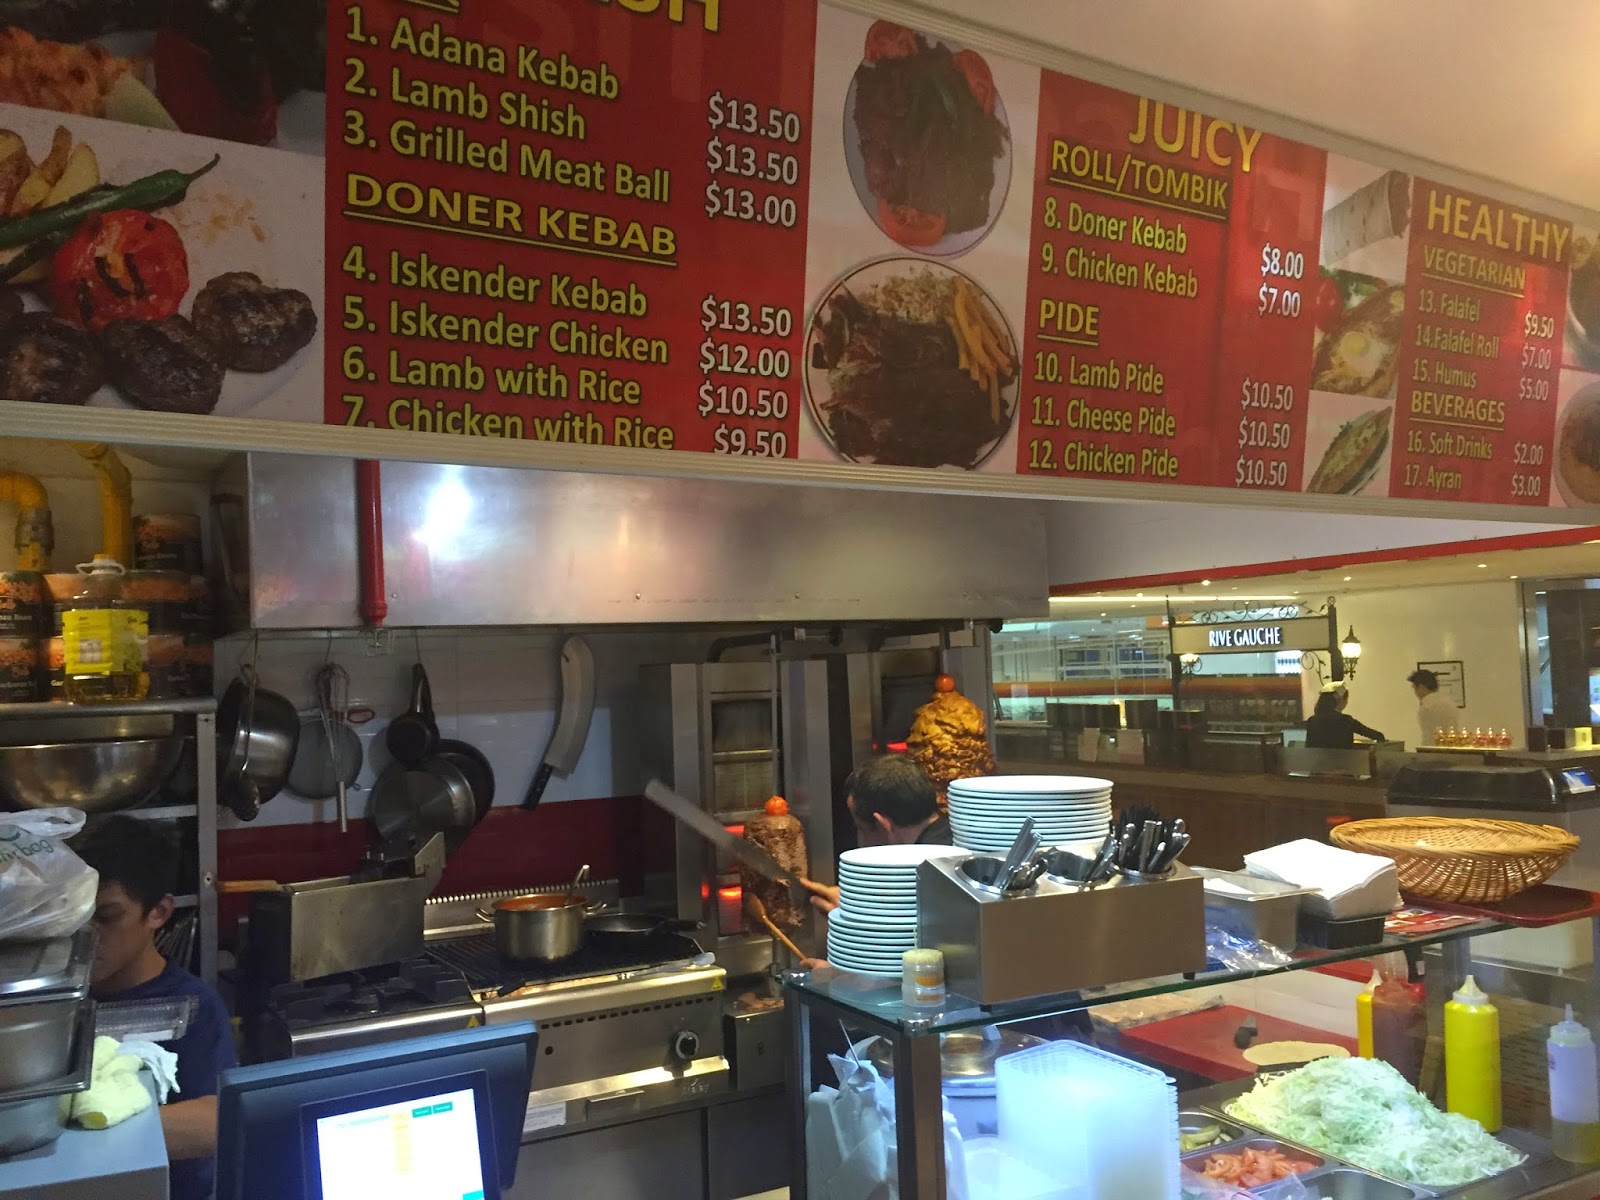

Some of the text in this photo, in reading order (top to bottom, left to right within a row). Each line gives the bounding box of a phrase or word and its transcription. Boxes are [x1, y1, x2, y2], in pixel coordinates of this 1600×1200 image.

[346, 7, 800, 142] 1. Adana Kebab $13.50
[344, 58, 798, 185] 2. Lamb Shish $13.50
[1128, 96, 1263, 172] JUICY
[343, 109, 796, 227] 3. Grilled Meat Ball $13.00
[1052, 140, 1228, 209] ROLL/TOMBIK
[346, 174, 676, 256] DONER KEBAB
[1044, 197, 1303, 279] 8. Doner Kebab $8.00
[1427, 190, 1569, 263] HEALTHY
[342, 246, 791, 337] 4. Iskender Kebab $13.50
[1041, 242, 1300, 317] 9. Chicken Kebab $7.00
[1424, 245, 1526, 290] VEGETARIAN
[343, 296, 790, 378] 5. Iskender Chicken $12.00
[1039, 299, 1099, 335] PIDE
[1418, 288, 1554, 338] 13. Falafel $9.50
[342, 346, 788, 418] 6. Lamb with Rice $10.50
[1034, 352, 1293, 411] 10. Lamb Pide $10.50
[1412, 358, 1549, 401] 15. Humus $5.00
[1477, 334, 1500, 359] Roll
[1521, 342, 1551, 370] $7.00
[342, 396, 787, 458] 7. Chicken with Rice $9.50
[1031, 396, 1290, 450] 11. Cheese Pide $10.50
[1411, 390, 1505, 423] BEVERAGES
[1028, 440, 1288, 488] 12. Chicken Pide $10.50
[1407, 429, 1544, 466] 16. Soft Drinks $2.00
[1403, 464, 1541, 497] 17. Ayran $3.00
[1208, 627, 1281, 647] RIVE GAUCHE
[13, 839, 54, 857] bag
